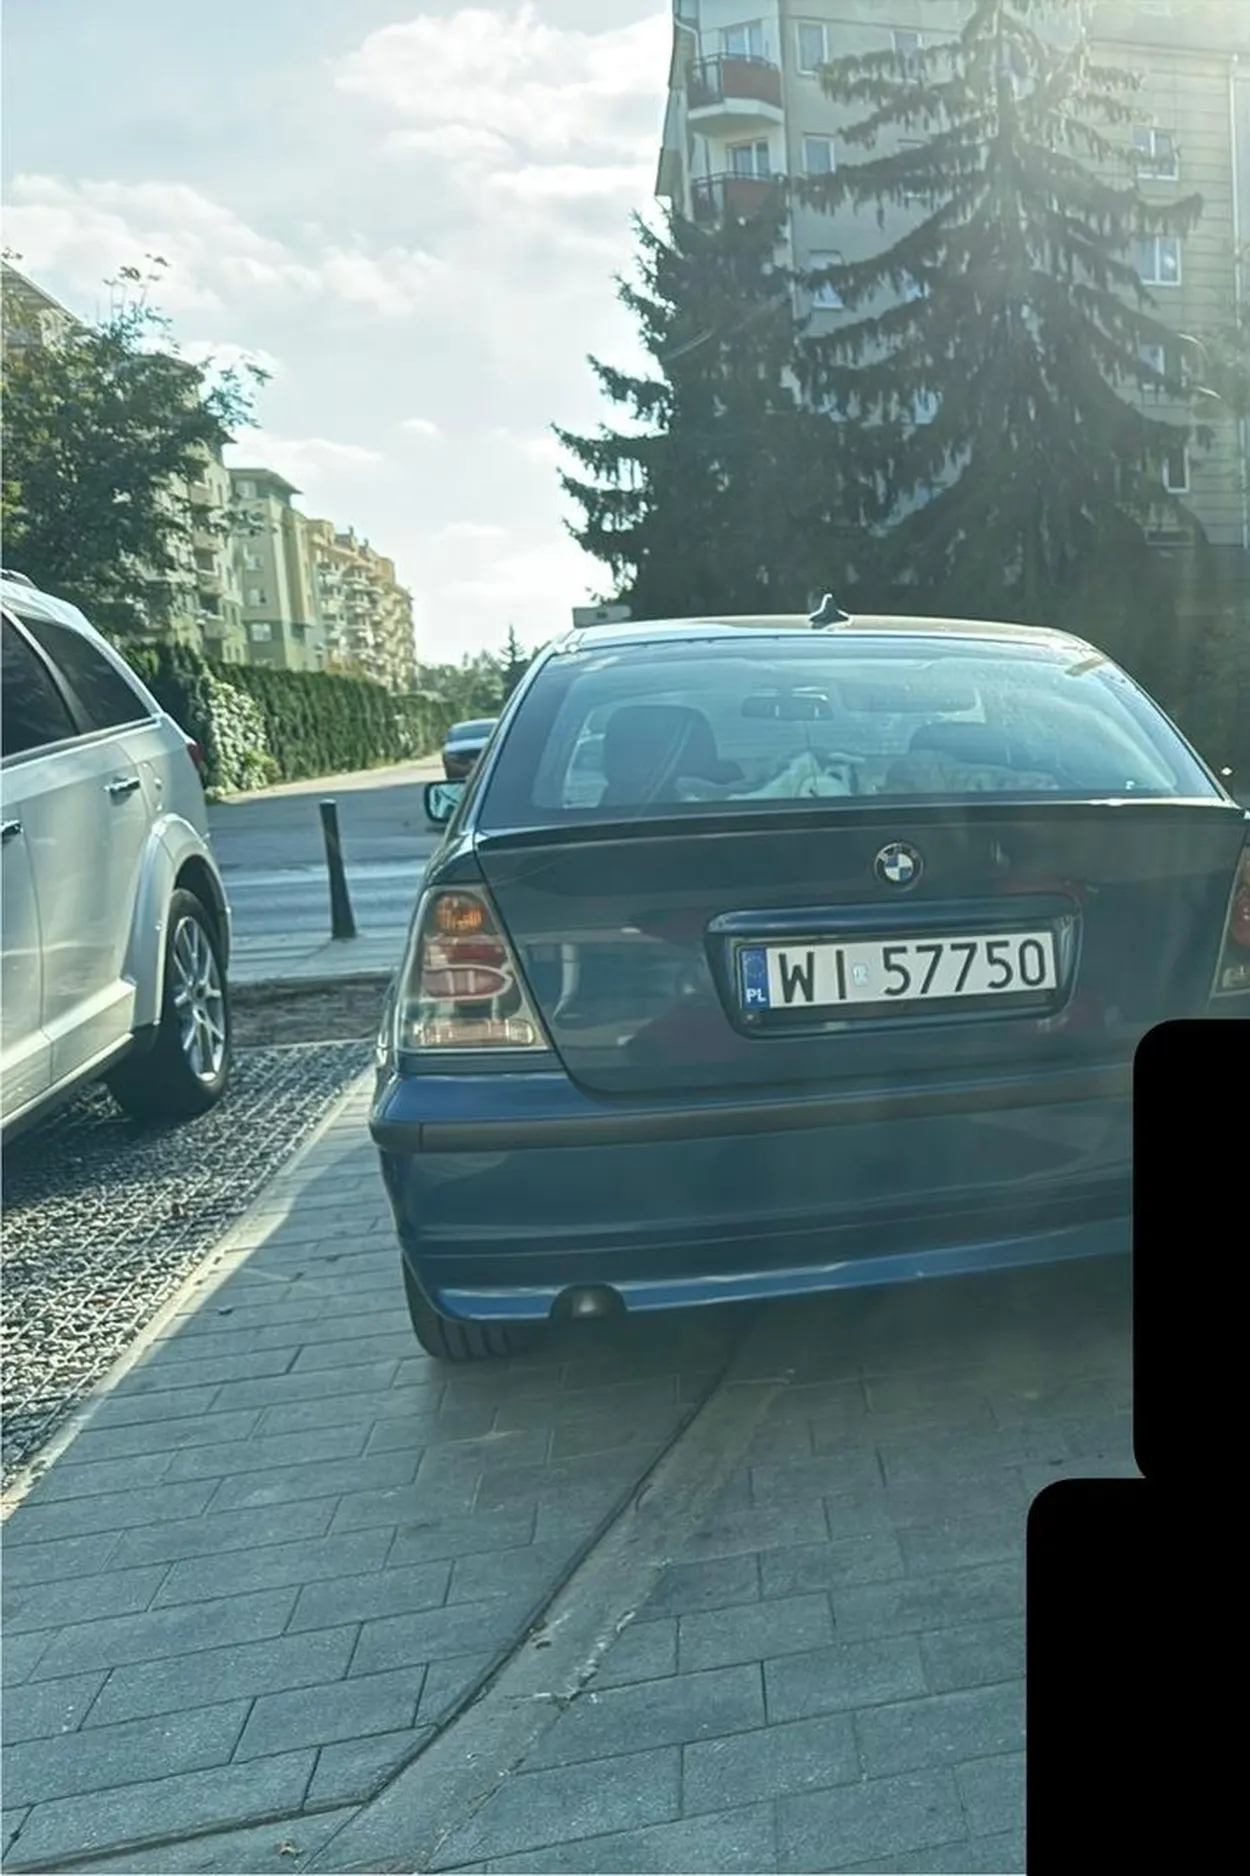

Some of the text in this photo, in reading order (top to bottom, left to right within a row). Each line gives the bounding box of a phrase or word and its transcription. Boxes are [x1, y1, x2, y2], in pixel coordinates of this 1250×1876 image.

[778, 938, 1047, 1003] WI 57750
[745, 987, 767, 1003] PL
